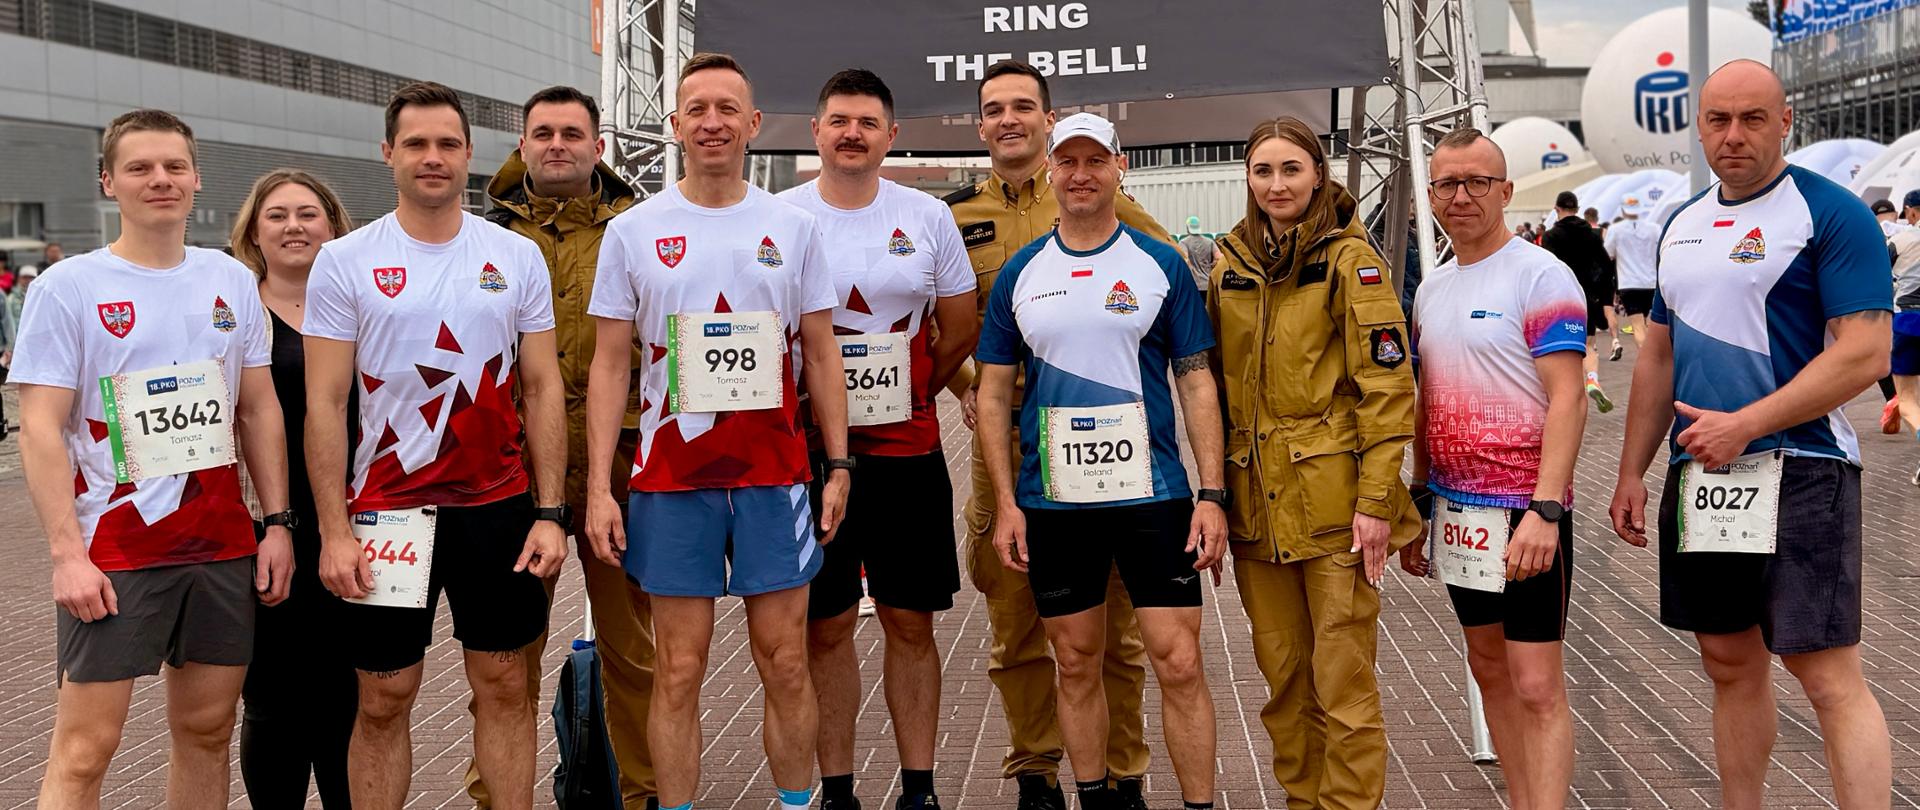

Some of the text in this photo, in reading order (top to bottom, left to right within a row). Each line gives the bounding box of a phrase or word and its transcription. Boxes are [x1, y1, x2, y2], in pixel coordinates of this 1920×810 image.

[984, 2, 1089, 33] RING
[1028, 45, 1147, 77] BELL!
[1623, 151, 1692, 168] Bank Po
[704, 347, 757, 373] 998
[149, 380, 177, 392] 18.PKO
[716, 376, 747, 385] Tomasz
[134, 399, 223, 436] 13642
[170, 433, 202, 445] Tomasz
[1062, 439, 1134, 466] 11320
[1083, 468, 1113, 477] Roland
[1694, 485, 1760, 511] 8027
[1443, 522, 1490, 551] 8142
[355, 537, 418, 567] 644
